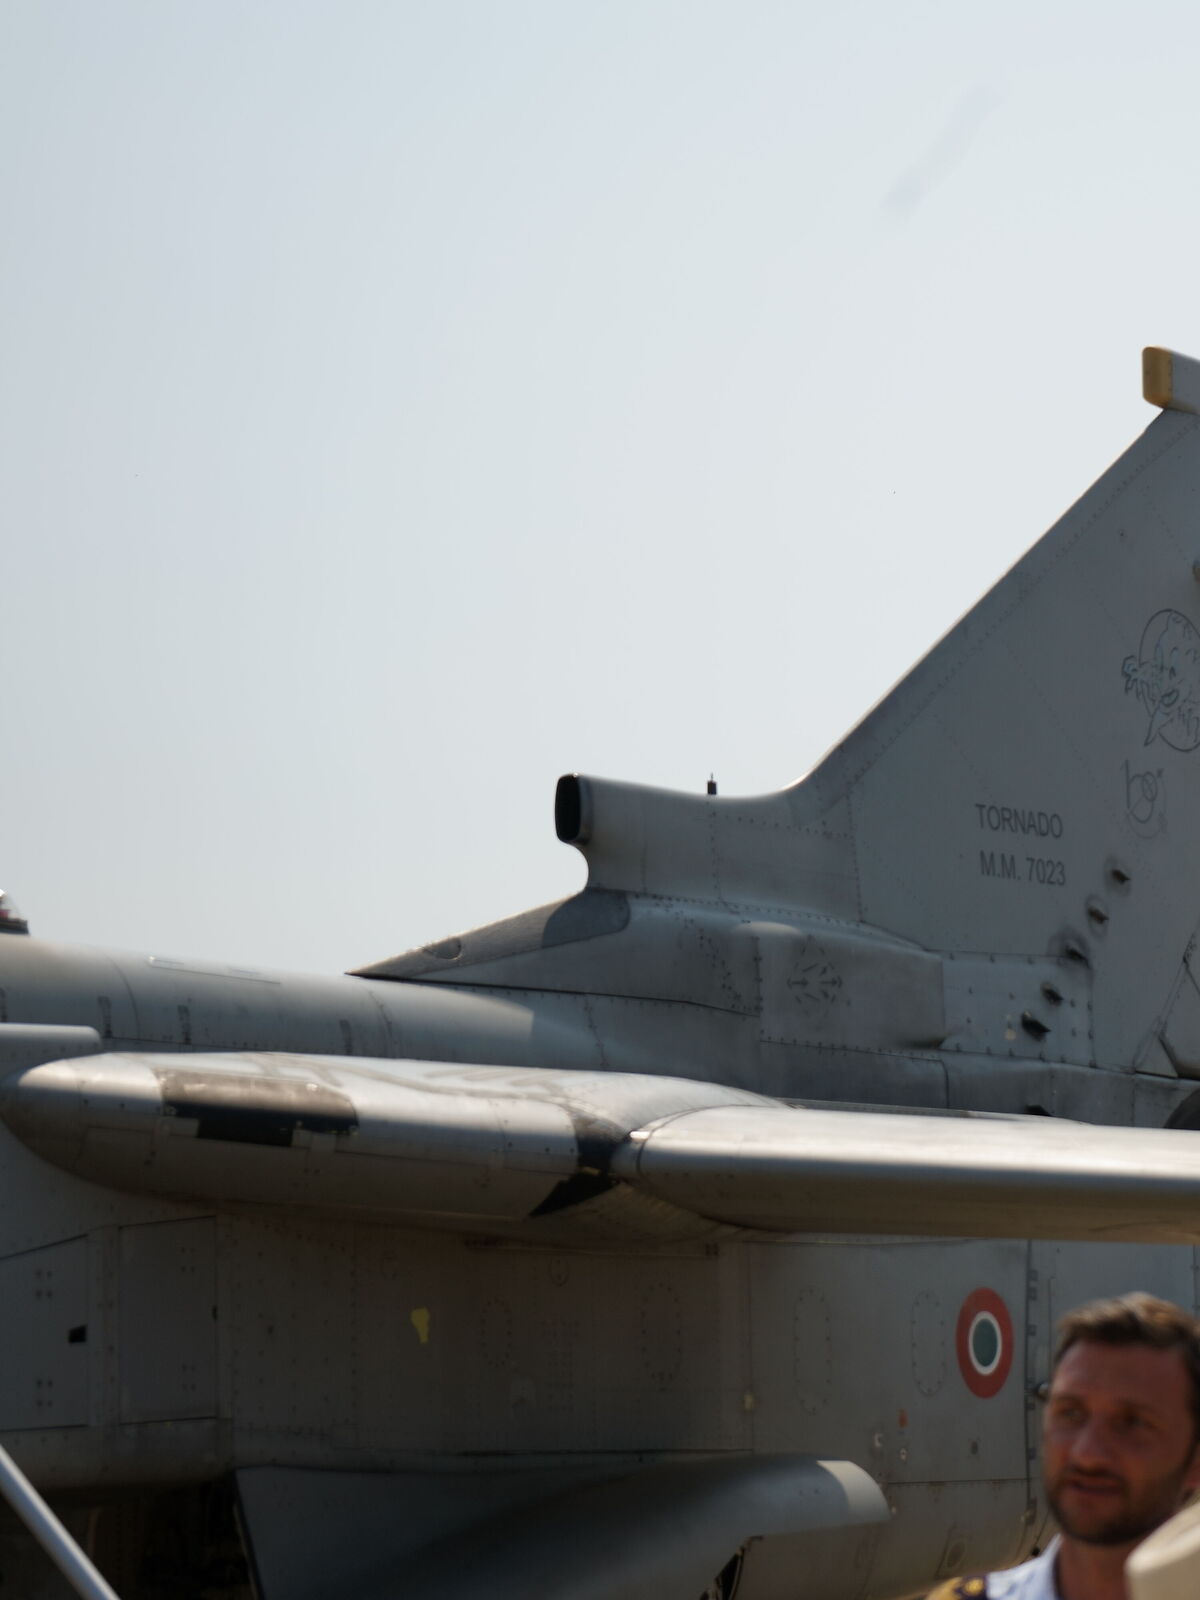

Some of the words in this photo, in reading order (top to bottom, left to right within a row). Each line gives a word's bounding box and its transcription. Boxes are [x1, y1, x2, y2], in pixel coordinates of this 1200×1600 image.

[974, 803, 1063, 839] TORNADO
[979, 850, 1021, 881] M.M.
[1026, 856, 1066, 886] 7023
